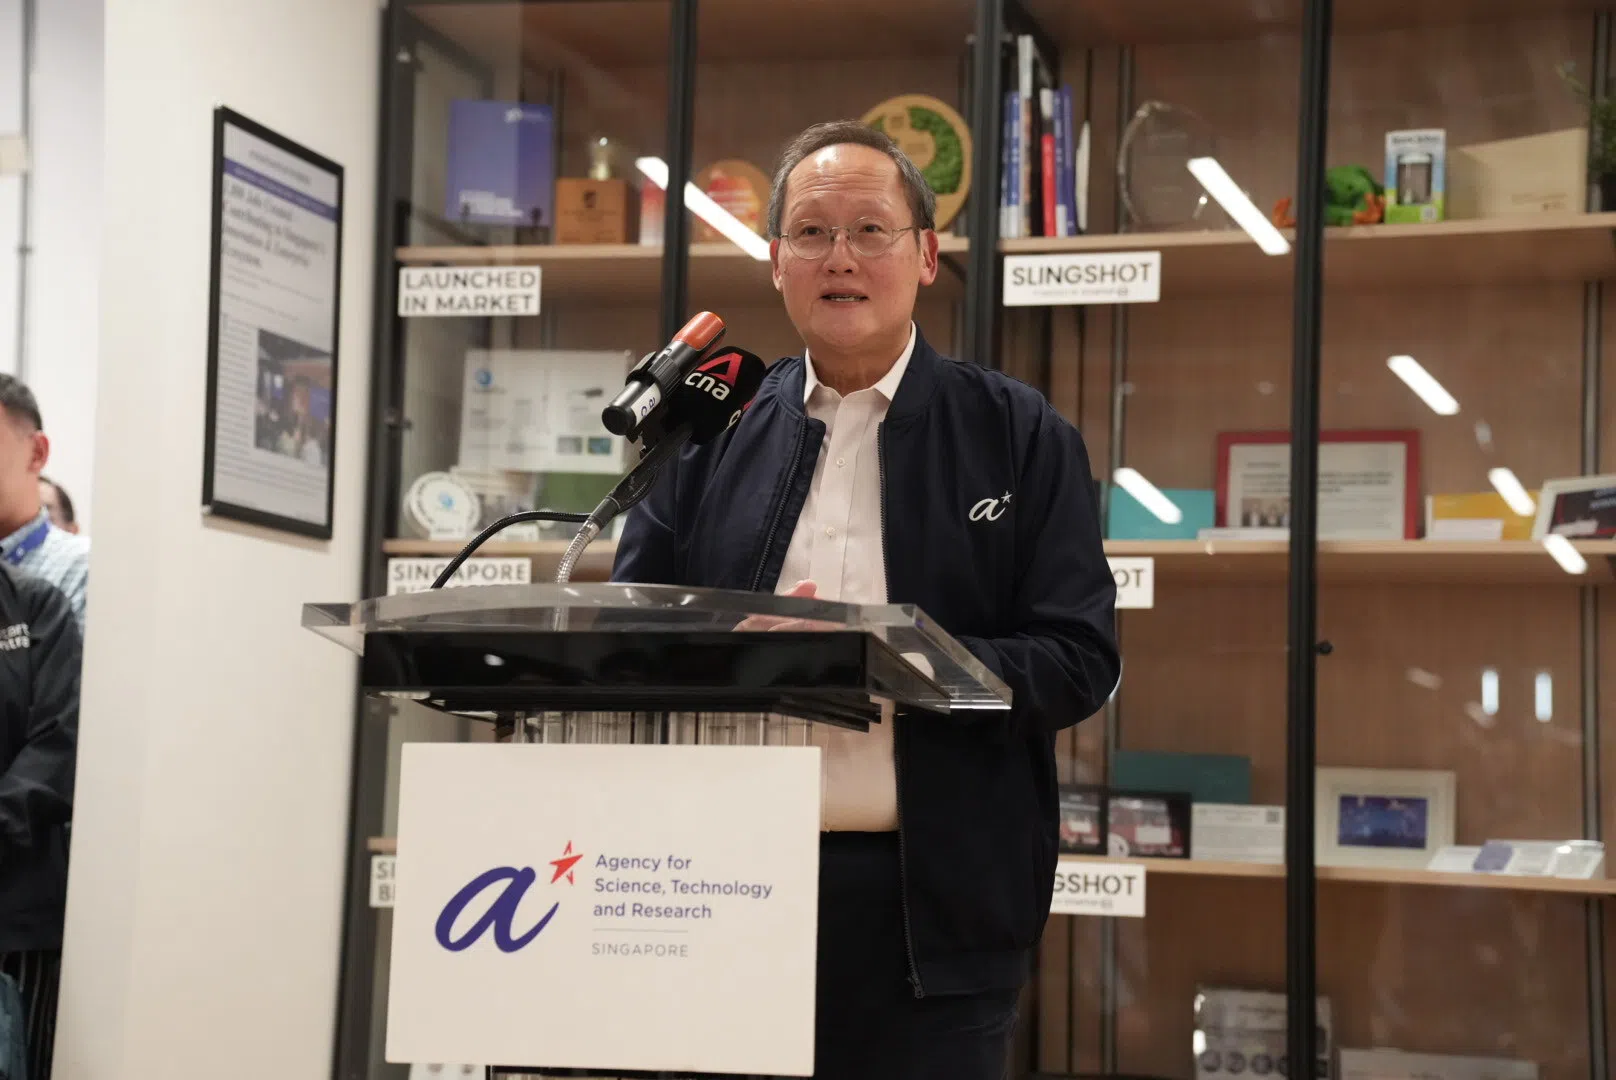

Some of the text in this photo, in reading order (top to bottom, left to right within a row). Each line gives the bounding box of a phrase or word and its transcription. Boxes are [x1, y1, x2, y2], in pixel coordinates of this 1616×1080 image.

[405, 271, 536, 289] LAUNCHED
[1012, 263, 1152, 286] SLINGSHOT
[404, 295, 534, 311] IN MARKET
[684, 372, 731, 401] cna
[595, 854, 692, 872] Agency for
[594, 877, 773, 899] Science, Technology
[593, 902, 712, 919] and Research
[591, 942, 689, 958] SINGAPORE
